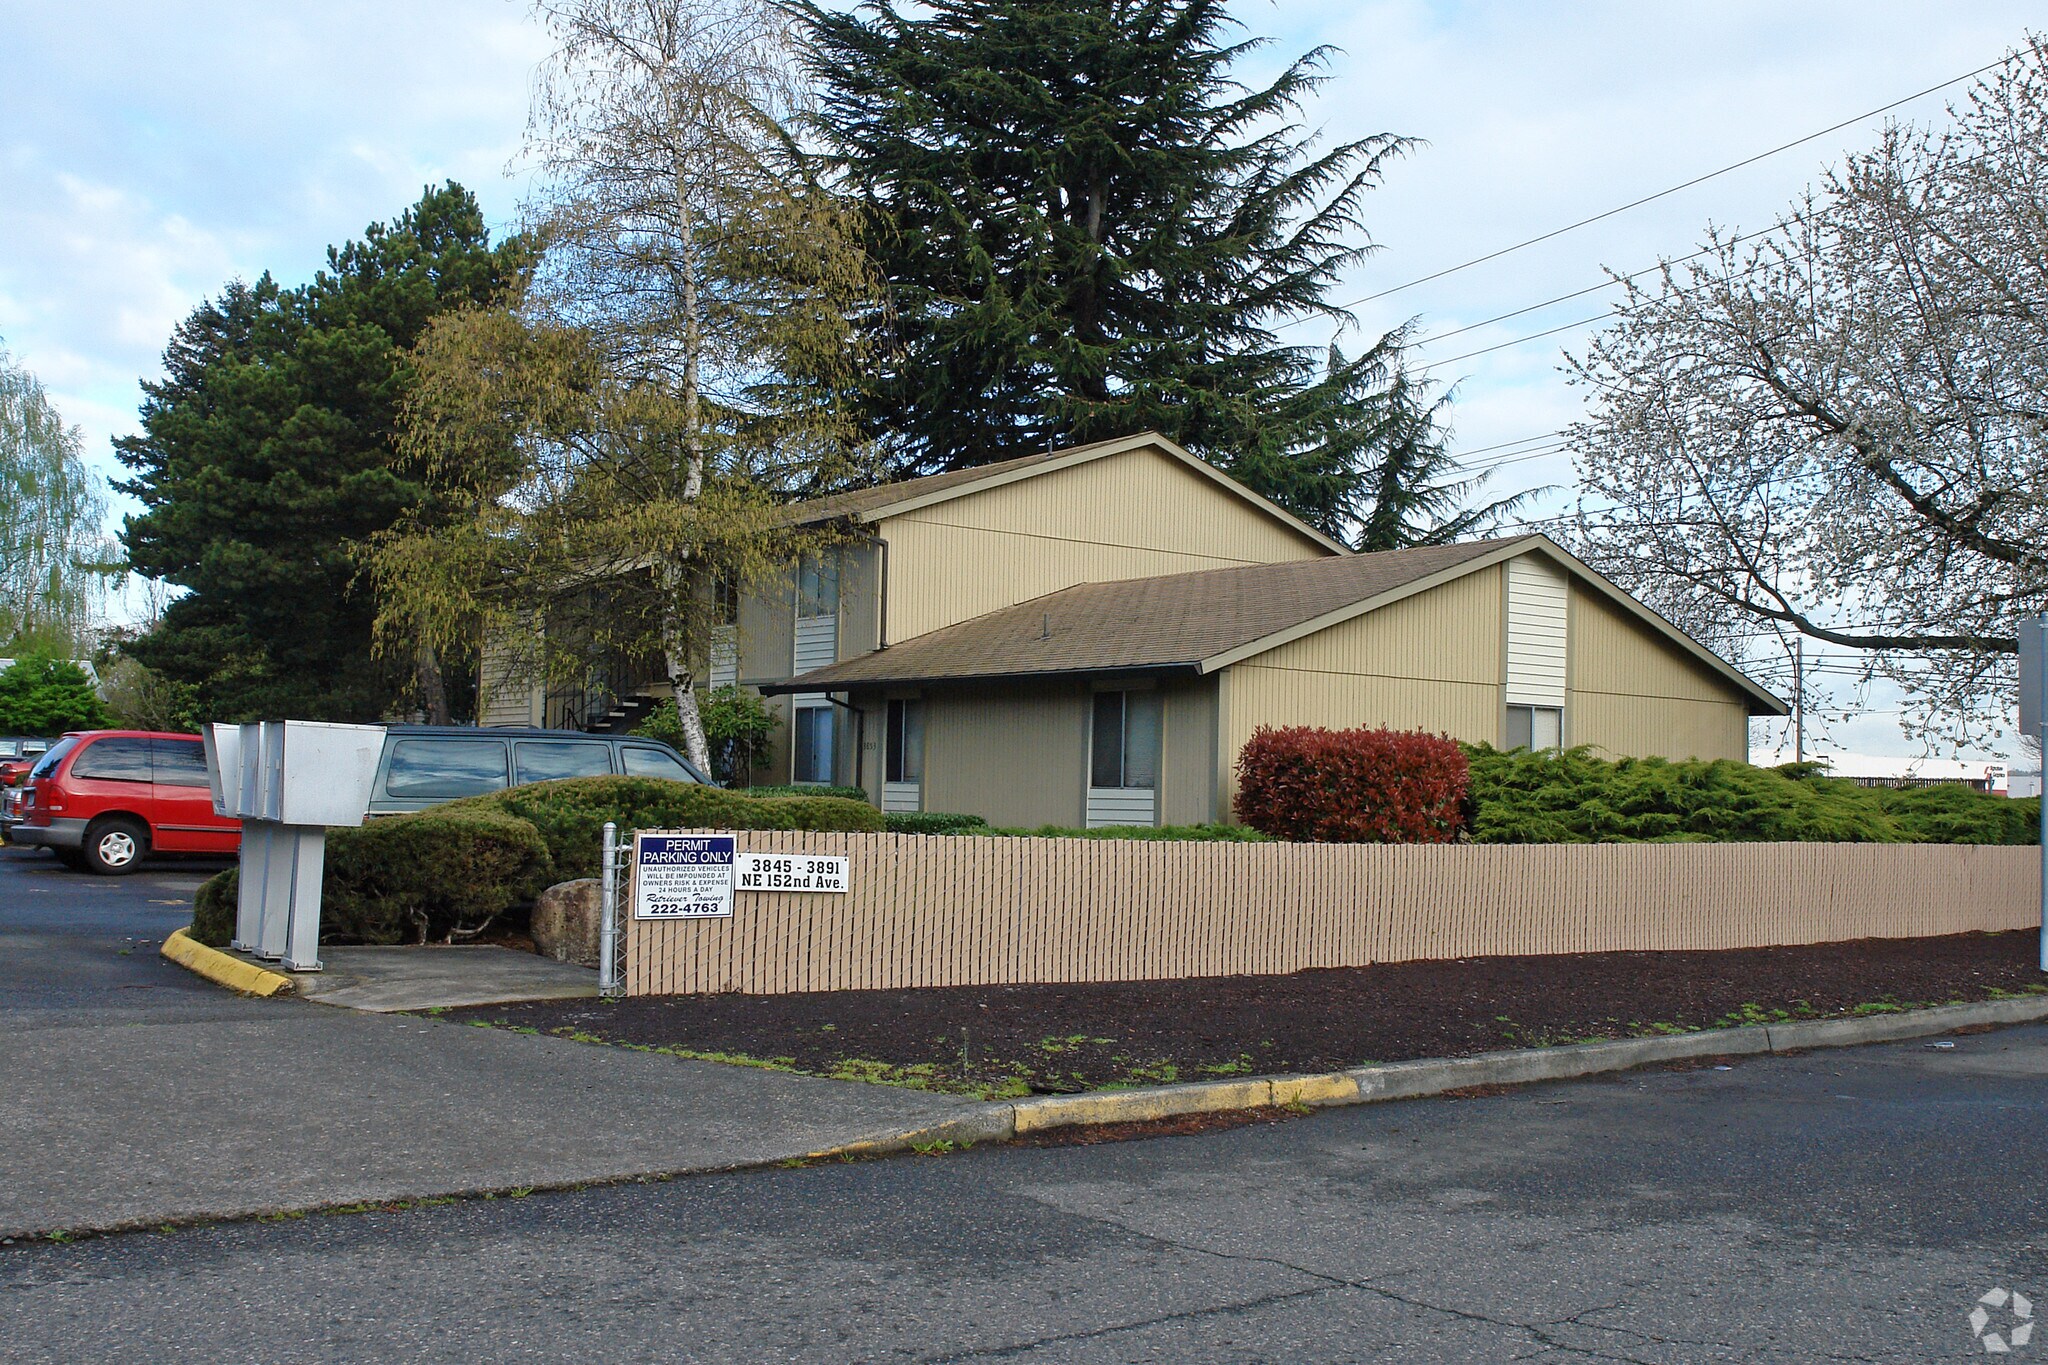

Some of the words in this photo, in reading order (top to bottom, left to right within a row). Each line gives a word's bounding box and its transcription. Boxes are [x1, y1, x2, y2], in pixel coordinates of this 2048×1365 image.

[666, 839, 711, 851] PERMIT
[643, 851, 697, 863] PARKING
[700, 851, 731, 863] ONLY
[752, 859, 792, 873] 3845
[806, 860, 840, 875] 3891
[742, 874, 761, 886] NE
[767, 873, 810, 888] 152nd
[816, 876, 844, 889] Ave.
[646, 893, 688, 902] Retriever
[692, 892, 724, 904] Towing
[650, 903, 719, 914] 222-4763
